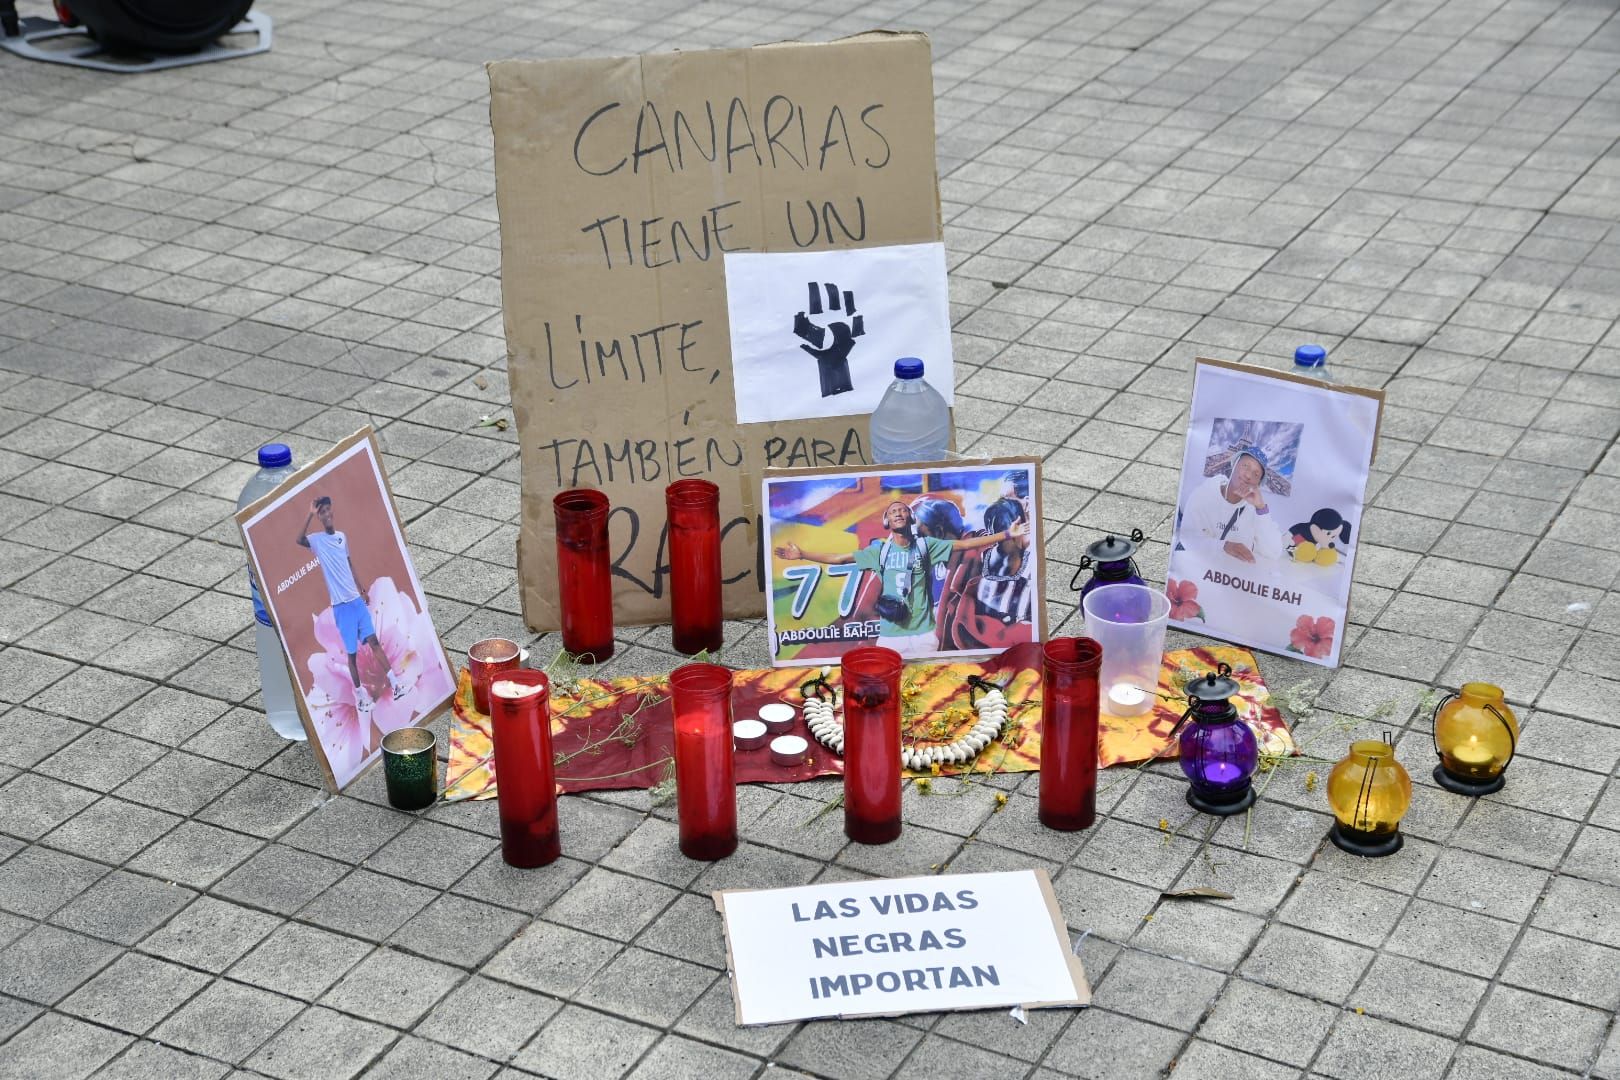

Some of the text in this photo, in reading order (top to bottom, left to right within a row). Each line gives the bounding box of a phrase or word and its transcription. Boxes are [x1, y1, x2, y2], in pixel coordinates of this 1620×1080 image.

[573, 95, 891, 176] CANARIAS
[581, 196, 866, 270] TIENE UN
[539, 410, 866, 487] TAMBIÉN PARA
[277, 566, 308, 596] ABDOULIE
[305, 556, 321, 572] BAH
[1203, 569, 1302, 606] ABDOULIE BAH
[791, 889, 979, 923] LAS VIDAS
[812, 927, 967, 959] NEGRAS
[809, 964, 1001, 1000] IMPORTAN
